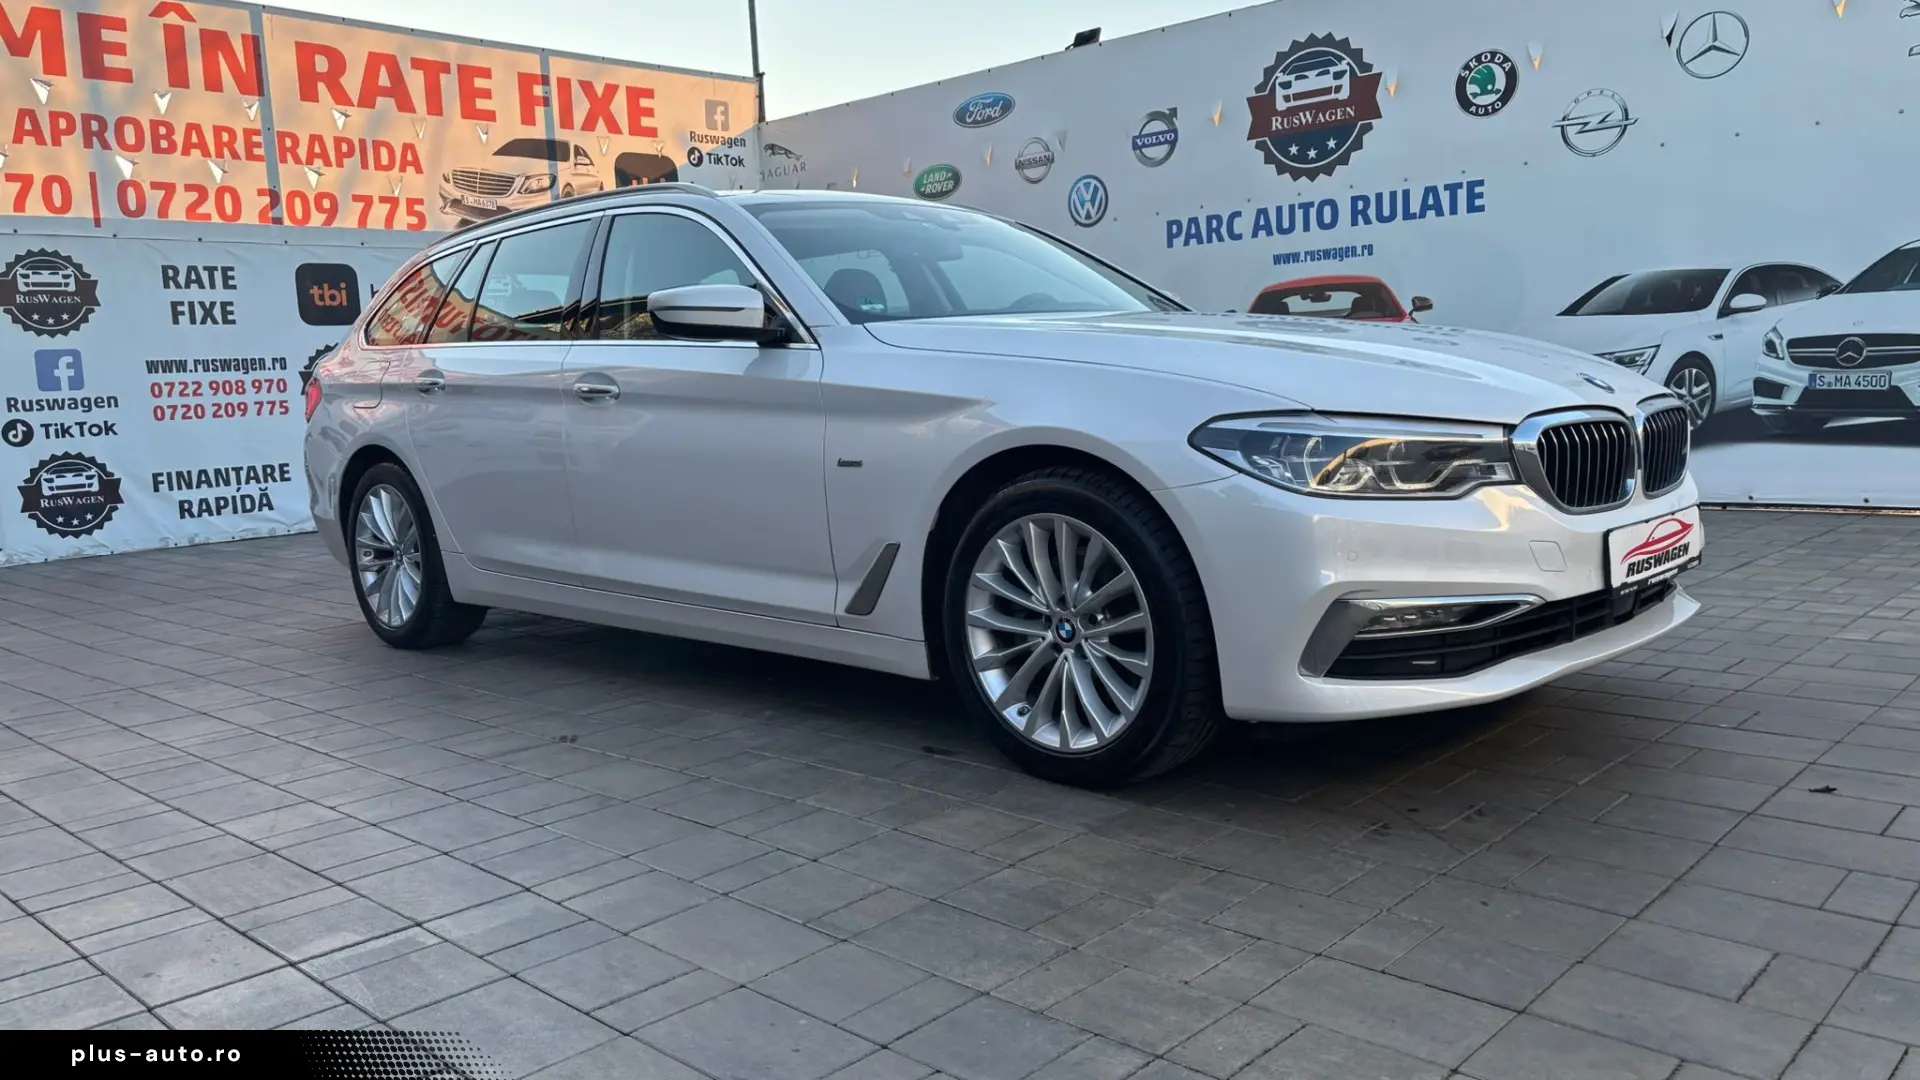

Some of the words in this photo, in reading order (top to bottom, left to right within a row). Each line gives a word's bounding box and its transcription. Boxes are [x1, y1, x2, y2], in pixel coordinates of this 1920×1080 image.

[148, 1, 265, 97] ÎN
[294, 40, 497, 123] RATE
[516, 71, 659, 138] FIXE
[966, 97, 1004, 123] Ford
[1469, 101, 1502, 115] AUTO
[12, 108, 264, 161] APROBARE
[277, 130, 424, 174] RAPIDA
[689, 130, 746, 148] Ruswagen
[1136, 132, 1175, 146] VOLVO
[706, 152, 746, 168] TikTok
[1018, 153, 1050, 168] NISSAN
[760, 161, 807, 182] JAGUAR
[922, 169, 947, 184] LAND
[924, 180, 955, 194] ROVER
[116, 179, 243, 223] 0720
[257, 188, 339, 227] 209
[351, 193, 427, 231] 775
[1166, 211, 1243, 248] PARC
[1251, 198, 1339, 239] AUTO
[1350, 179, 1486, 228] RULATE
[1273, 243, 1374, 266] www.ruswagen.ro
[161, 264, 237, 290] RATE
[309, 282, 348, 306] tbi
[170, 300, 237, 325] FIXE
[145, 352, 287, 374] www.ruswagen.ro
[150, 380, 203, 399] 0722
[208, 379, 247, 396] 908
[251, 378, 288, 394] 970
[1854, 374, 1887, 388] 4500
[6, 395, 119, 413] Ruswagen
[153, 403, 206, 421] 0720
[212, 401, 249, 419] 209
[253, 400, 290, 416] 775
[40, 420, 119, 439] TikTok
[178, 486, 275, 519] RAPIDĂ
[1625, 541, 1691, 578] RUSWAGEN
